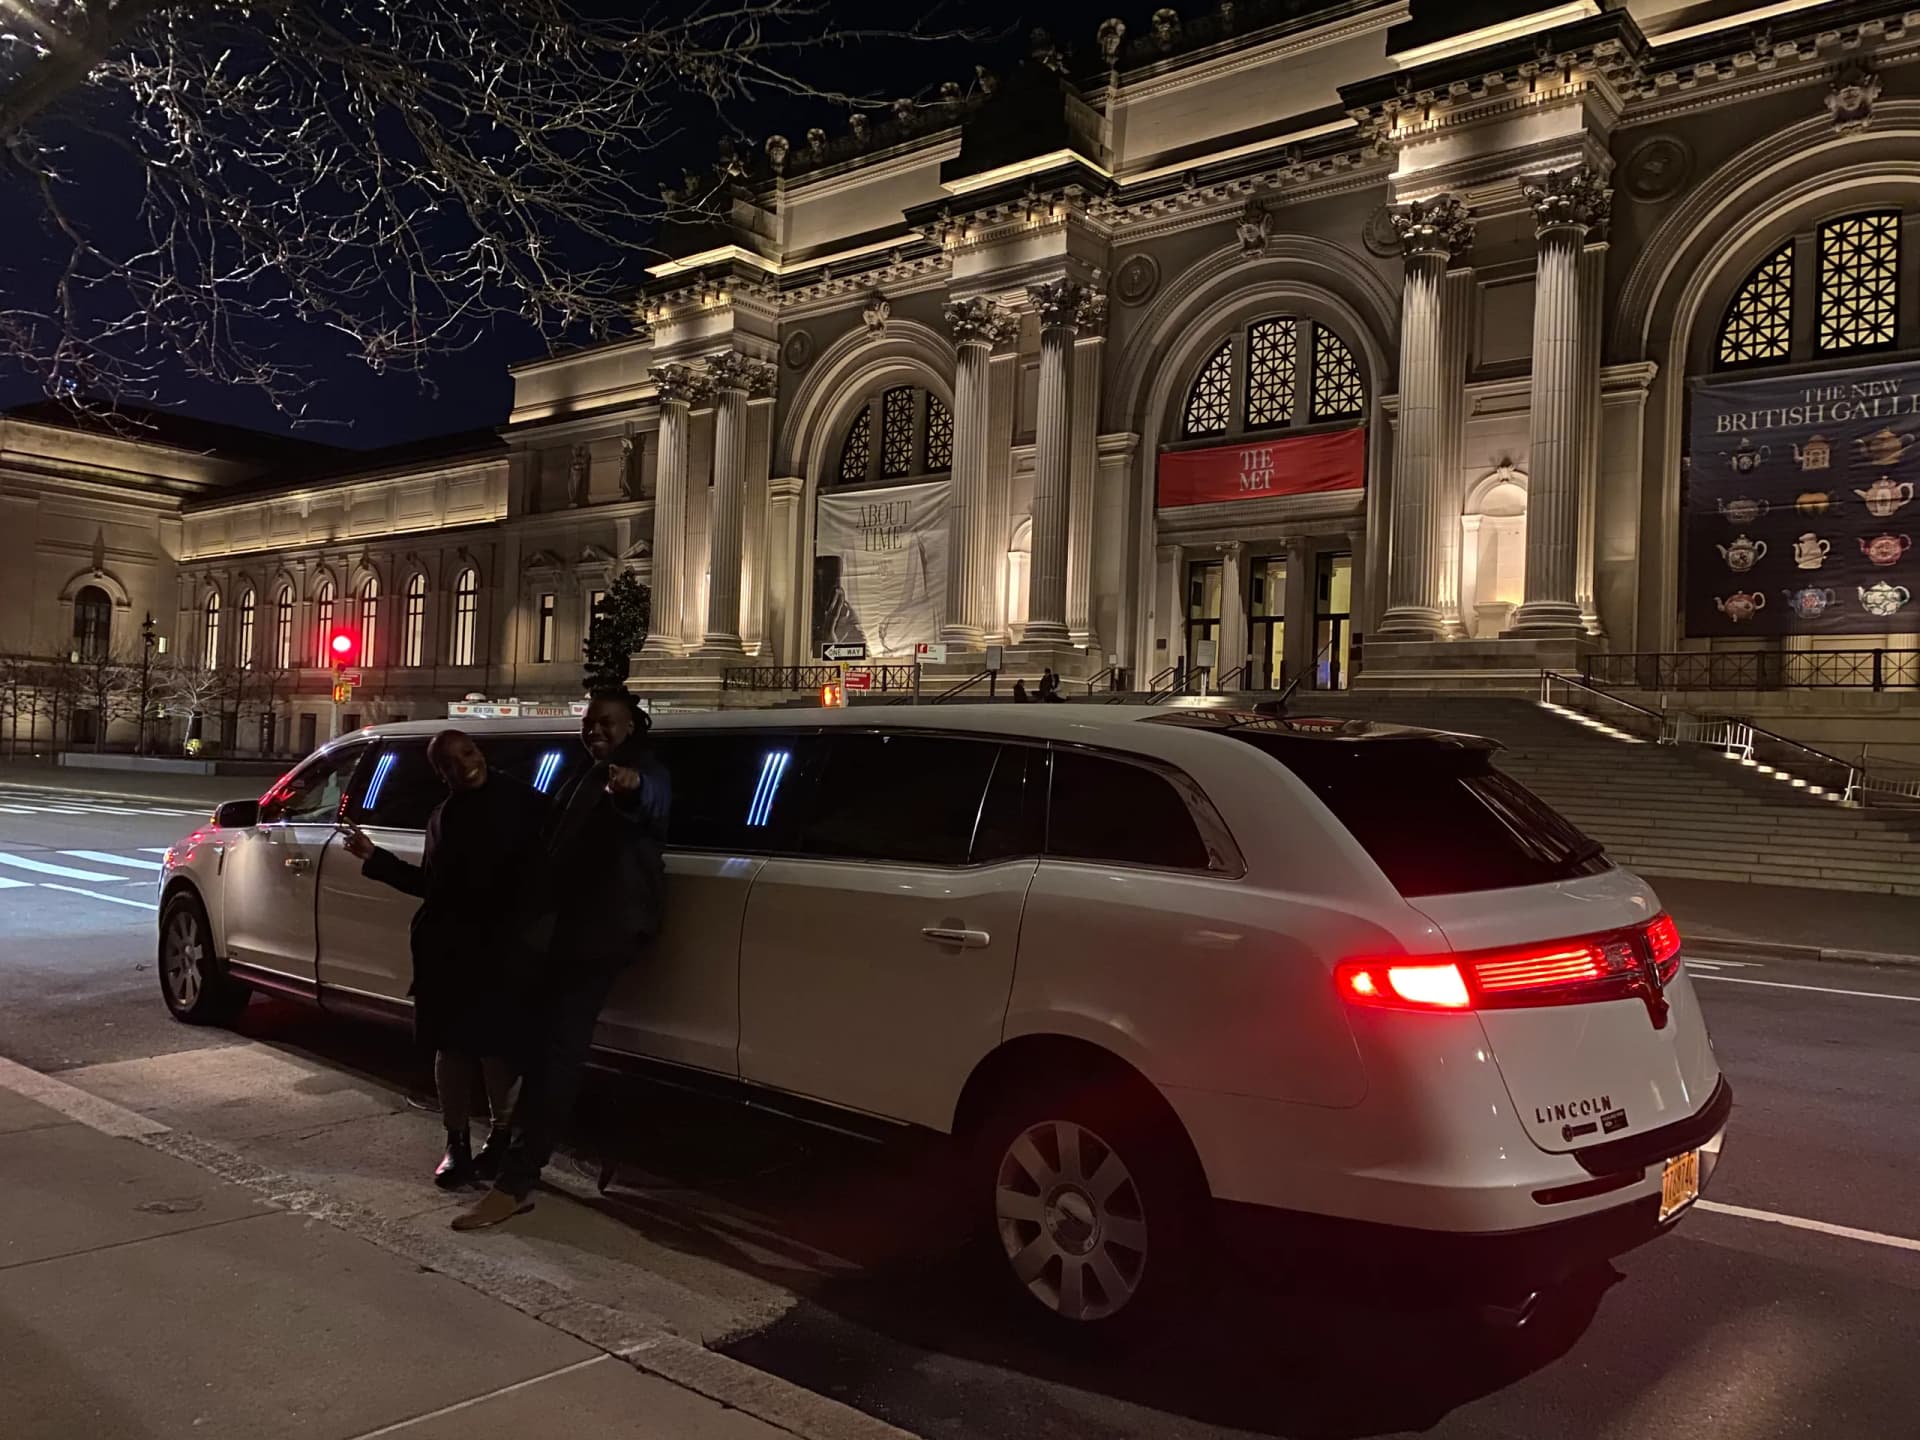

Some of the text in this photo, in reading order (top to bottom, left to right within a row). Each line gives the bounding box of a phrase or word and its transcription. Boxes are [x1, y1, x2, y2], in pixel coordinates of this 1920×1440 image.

[1800, 379, 1903, 403] THE NEW
[1716, 404, 1824, 433] BRITISH
[1239, 448, 1274, 470] THE
[1239, 469, 1275, 492] MET
[856, 500, 911, 528] ABOUT
[862, 526, 902, 552] TIME
[829, 648, 860, 657] ONE WAY
[536, 707, 564, 716] WATER
[1535, 1095, 1612, 1123] LINCOLN
